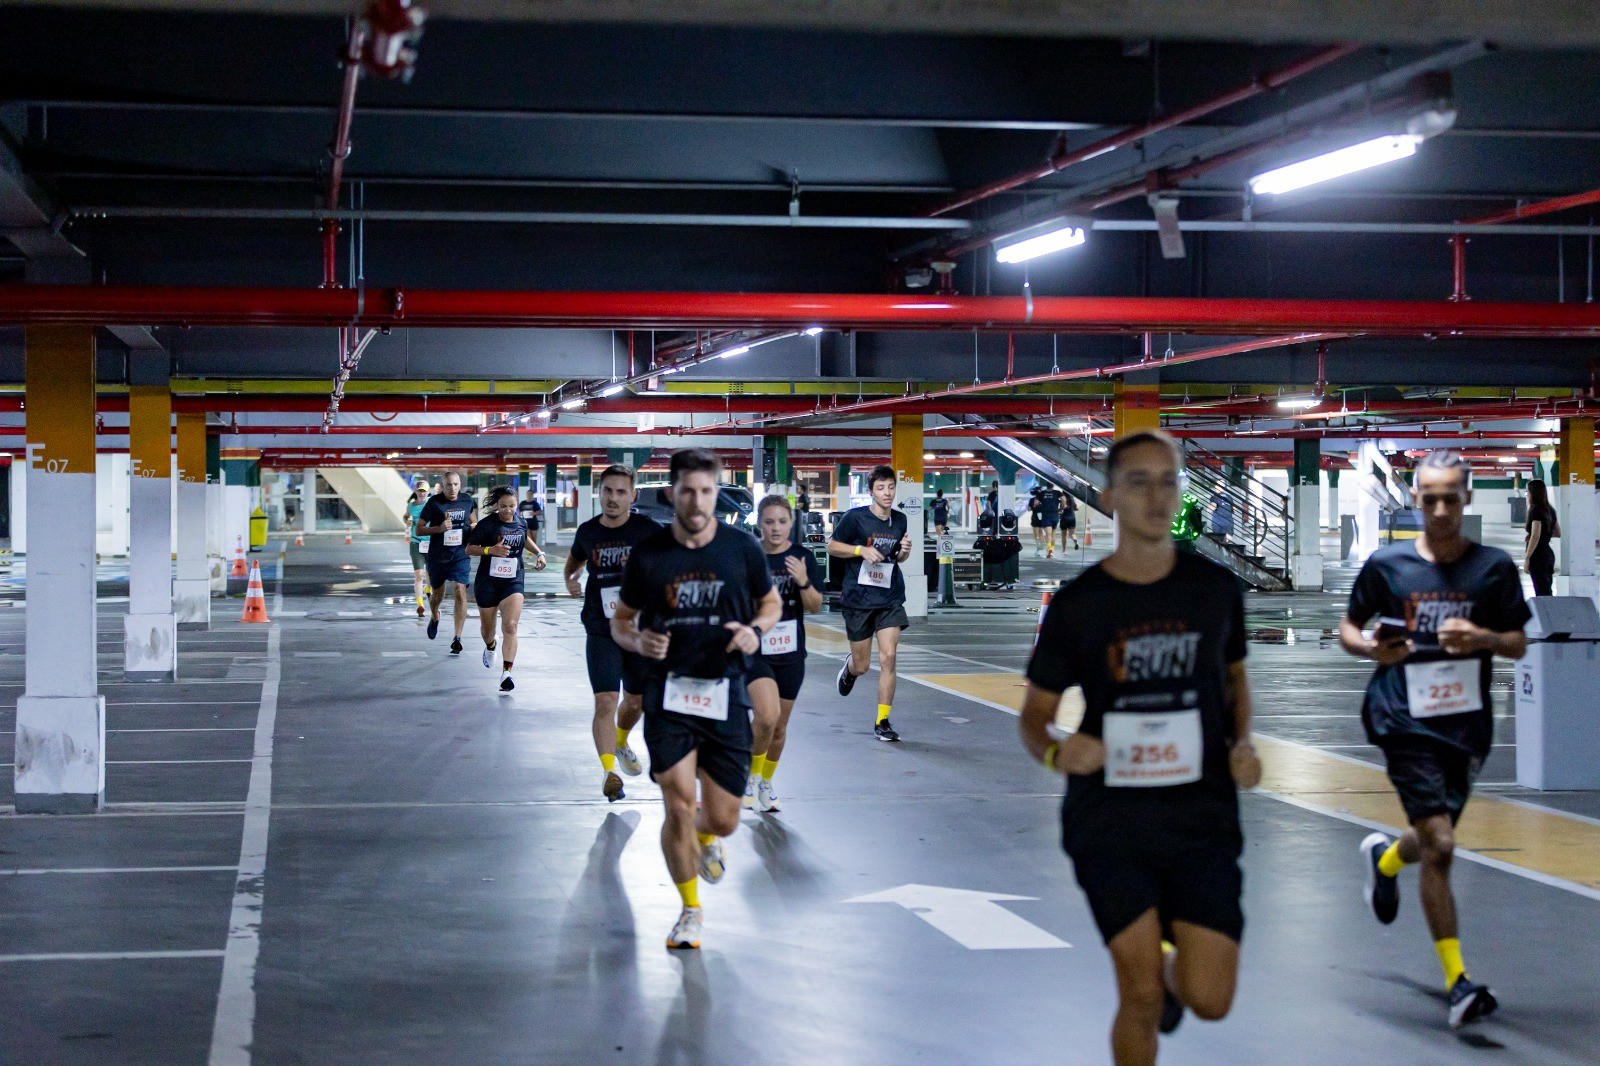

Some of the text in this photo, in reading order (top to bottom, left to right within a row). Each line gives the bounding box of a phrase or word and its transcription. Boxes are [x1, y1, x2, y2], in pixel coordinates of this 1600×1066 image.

[498, 565, 512, 573] 053
[868, 571, 883, 579] 180
[769, 636, 791, 646] 018
[1130, 744, 1180, 764] 256
